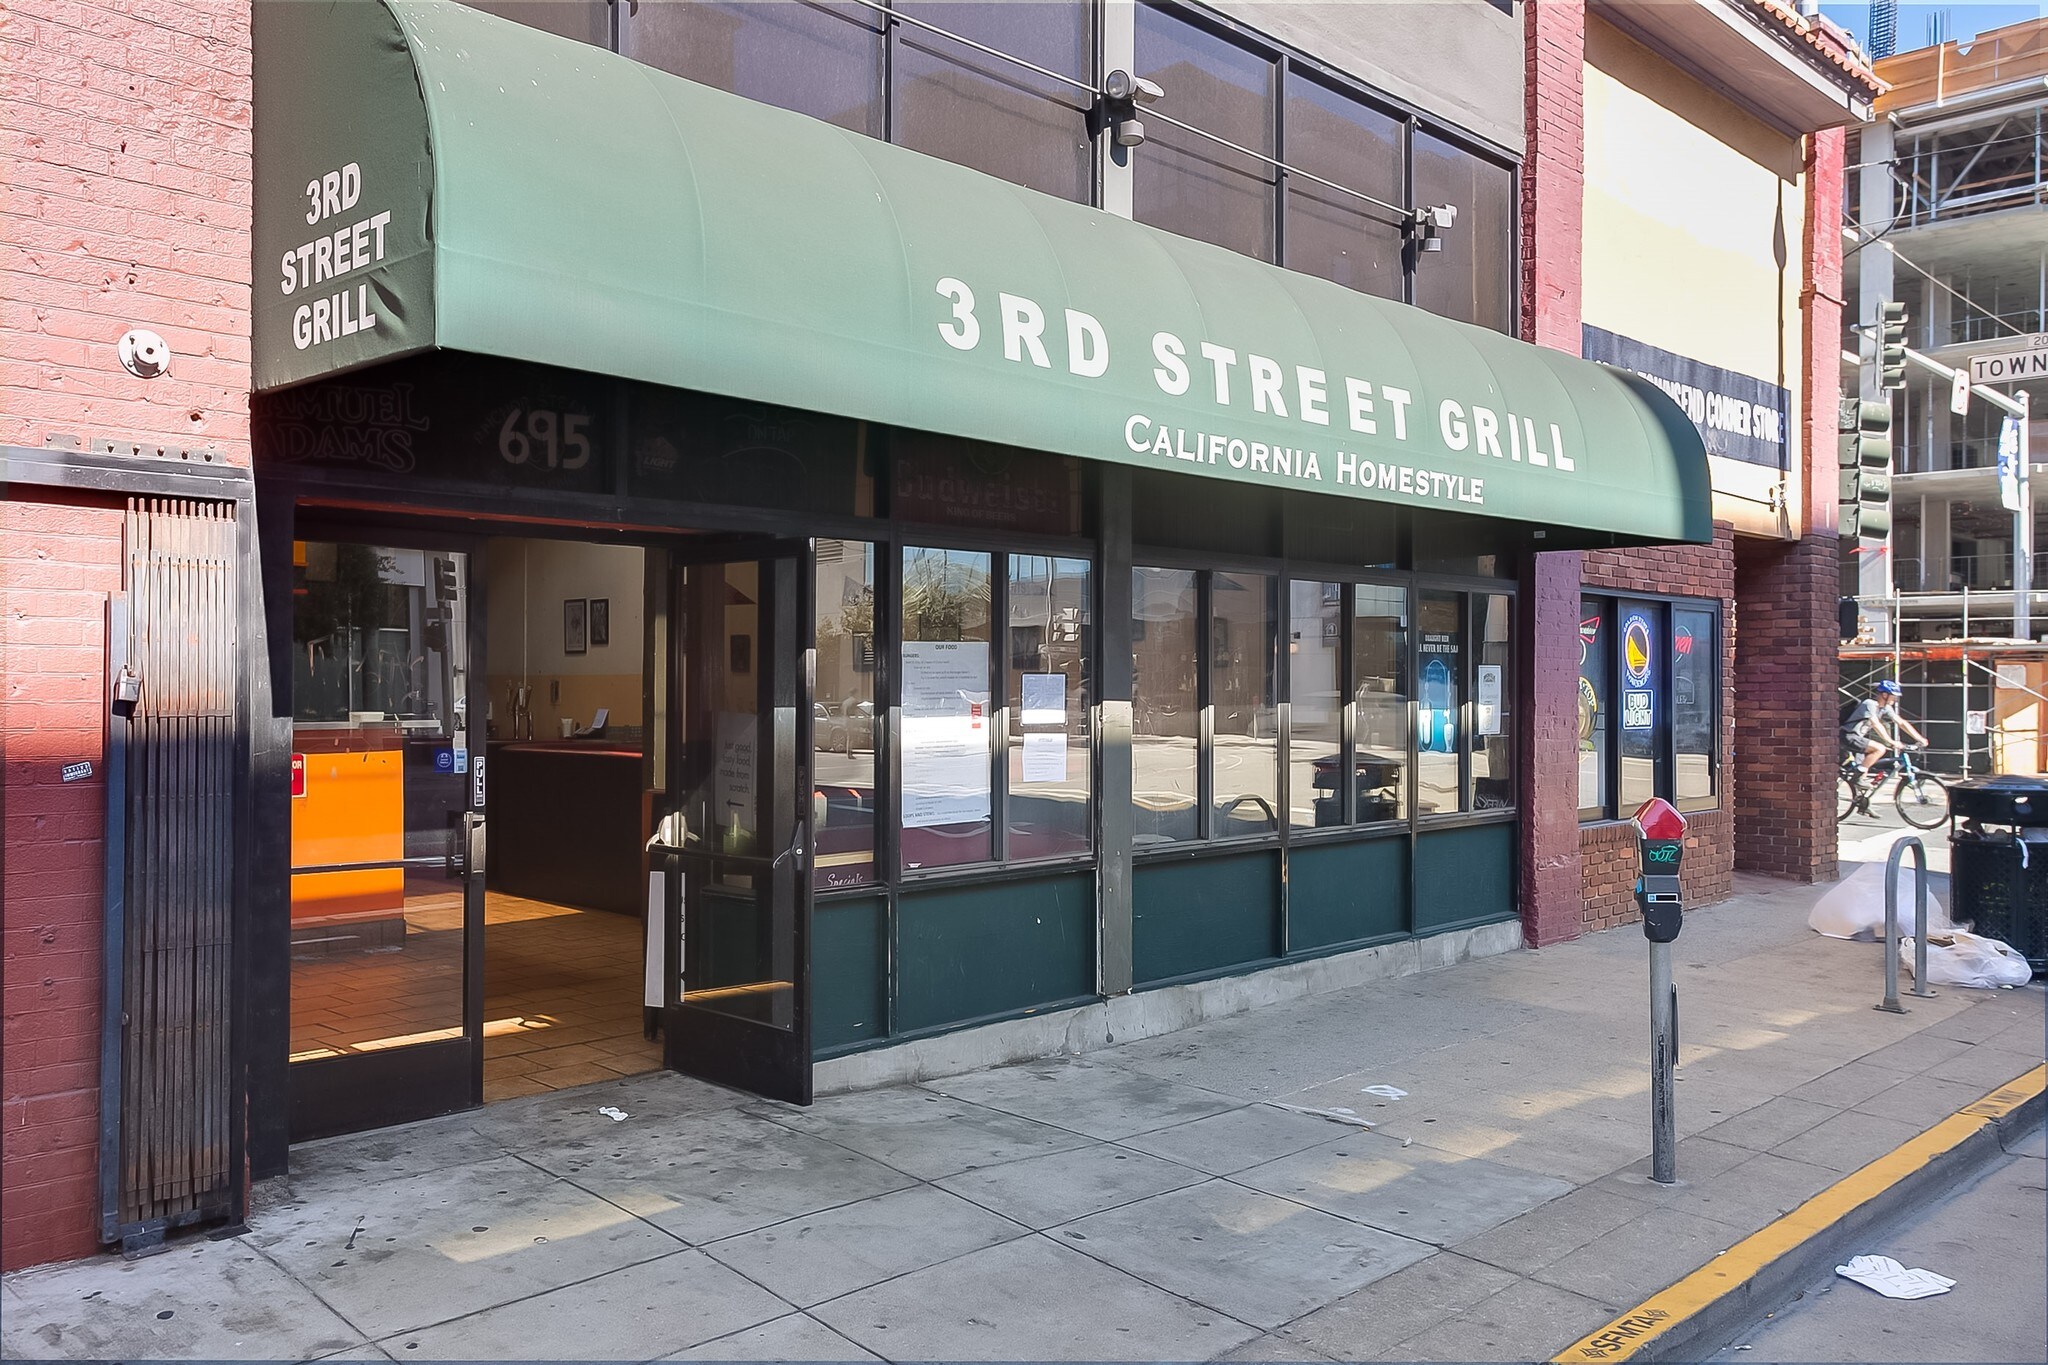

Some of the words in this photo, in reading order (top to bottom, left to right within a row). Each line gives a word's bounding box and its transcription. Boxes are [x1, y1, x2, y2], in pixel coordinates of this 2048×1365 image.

[305, 161, 362, 226] 3RD
[280, 209, 391, 296] STREET
[292, 283, 376, 350] GRILL
[935, 275, 1110, 379] 3RD
[1151, 330, 1412, 440] STREET
[1438, 397, 1576, 472] GRILL
[1975, 354, 2047, 379] TOWN
[499, 408, 590, 470] 695
[1705, 390, 1752, 437] CORNER
[1752, 404, 1784, 444] STORE
[1123, 413, 1322, 483] CALIFORNIA
[1335, 450, 1486, 505] HOMESTYLE
[1625, 709, 1652, 727] LIGHT
[1628, 693, 1649, 710] BUD
[1590, 1315, 1663, 1352] SFMTA
